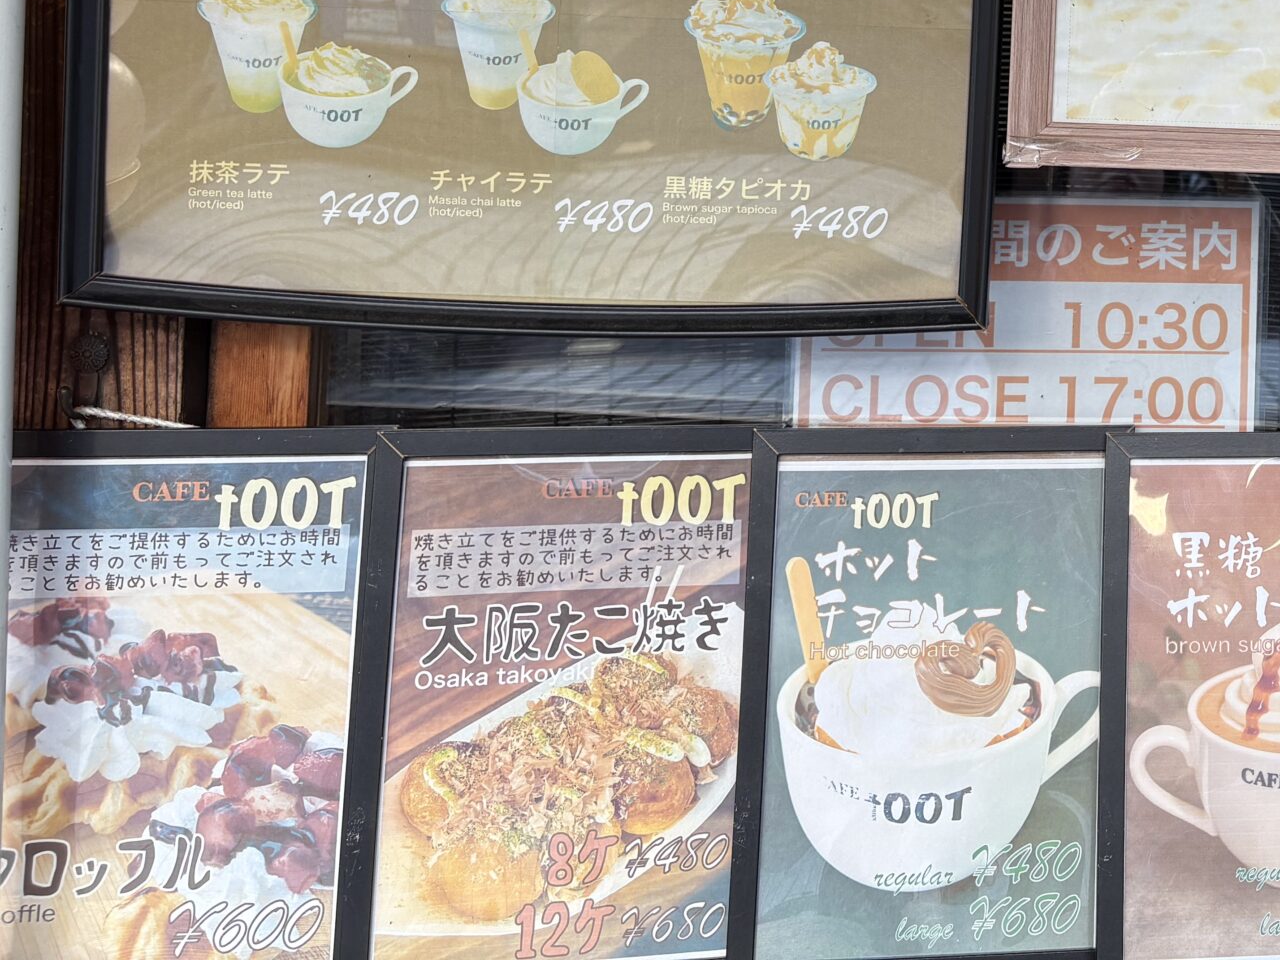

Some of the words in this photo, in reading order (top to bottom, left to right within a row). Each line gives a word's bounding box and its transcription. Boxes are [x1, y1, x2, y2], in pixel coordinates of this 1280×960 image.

[189, 160, 290, 185] 抹茶ラテ
[430, 169, 552, 193] チャイラテ
[188, 187, 223, 199] Green
[225, 189, 244, 199] tea
[247, 188, 273, 199] latte
[428, 194, 465, 207] Masala
[468, 195, 494, 207] chai
[496, 196, 522, 208] latte
[662, 176, 812, 201] 黒糖タピオカ
[188, 198, 244, 211] (hot/iced)
[319, 190, 419, 226] ¥480
[428, 206, 483, 218] (hot/iced)
[554, 198, 654, 234] ¥480
[662, 202, 699, 213] Brown
[701, 205, 733, 216] sugar
[736, 204, 778, 216] tapioca
[662, 213, 717, 225] (hot/iced)
[790, 204, 889, 240] ¥480
[1064, 302, 1230, 352] 10:30
[822, 375, 1030, 424] CLOSE
[1058, 376, 1224, 424] 17:00
[132, 481, 210, 503] CAFE
[542, 477, 615, 500] CAFE
[795, 492, 849, 509] CAFE
[415, 524, 734, 552] 焼き立てをご提供するためにお時間
[416, 545, 733, 571] を頂きますので前もってご注文され
[815, 539, 938, 582] ホット
[1171, 531, 1265, 579] 黒糖
[8, 570, 263, 592] ことをお勧めいたします。
[415, 565, 663, 592] ることをお勧めいたします。
[815, 588, 1046, 638] チョコレート
[419, 596, 730, 668] 大阪たこ焼き
[1165, 636, 1231, 655] brown
[809, 640, 849, 660] Hot
[855, 639, 961, 660] chocolate
[415, 669, 489, 691] Osaka
[496, 663, 596, 687] takoyaki
[622, 833, 729, 879] ¥480
[874, 864, 955, 896] regular
[971, 839, 1083, 888] ¥480
[168, 898, 325, 959] ¥600
[621, 902, 727, 948] ¥680
[895, 917, 954, 949] large
[969, 892, 1081, 941] ¥680
